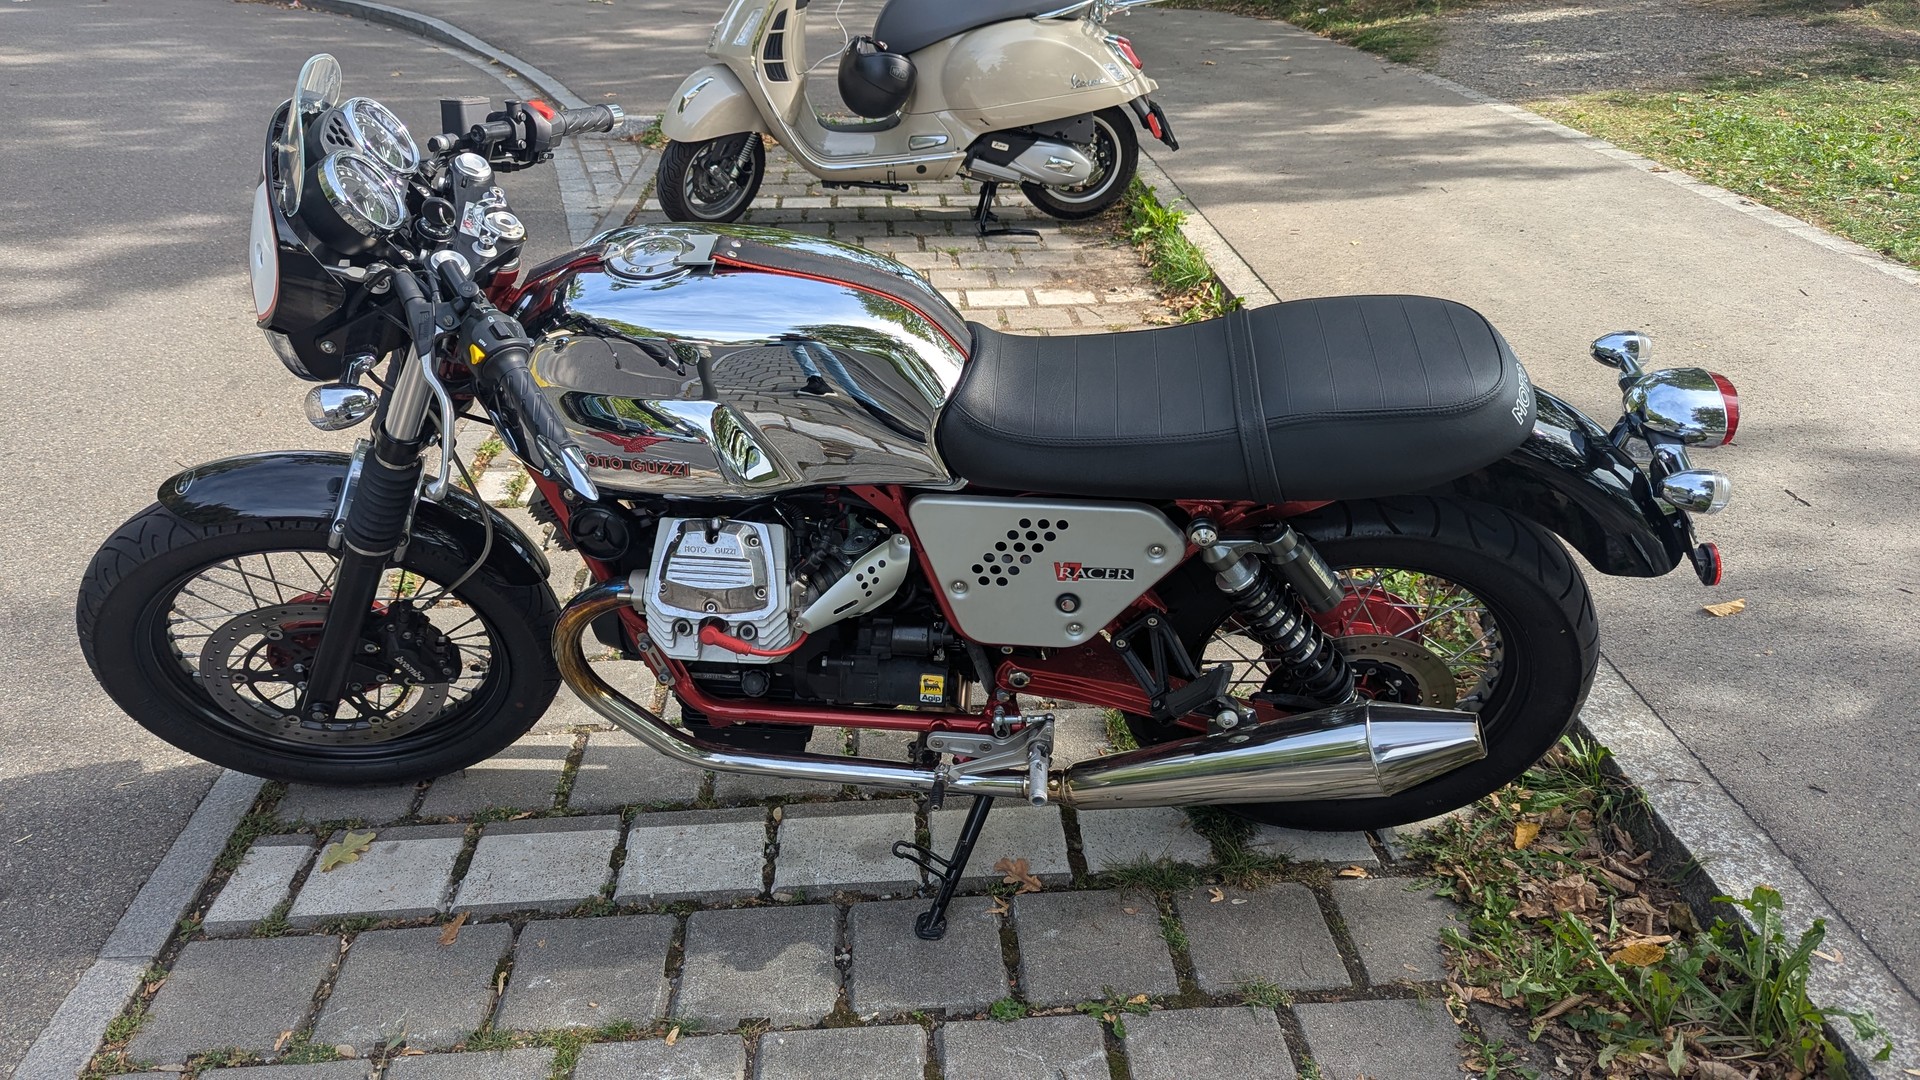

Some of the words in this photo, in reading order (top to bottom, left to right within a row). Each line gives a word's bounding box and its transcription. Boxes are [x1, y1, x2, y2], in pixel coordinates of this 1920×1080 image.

[584, 453, 623, 470] OTO
[629, 459, 690, 476] GUZZI
[684, 546, 707, 554] MOTO
[714, 547, 736, 555] GUZZI
[1059, 567, 1132, 580] RACER
[394, 656, 425, 681] brembo
[922, 694, 941, 702] Agip
